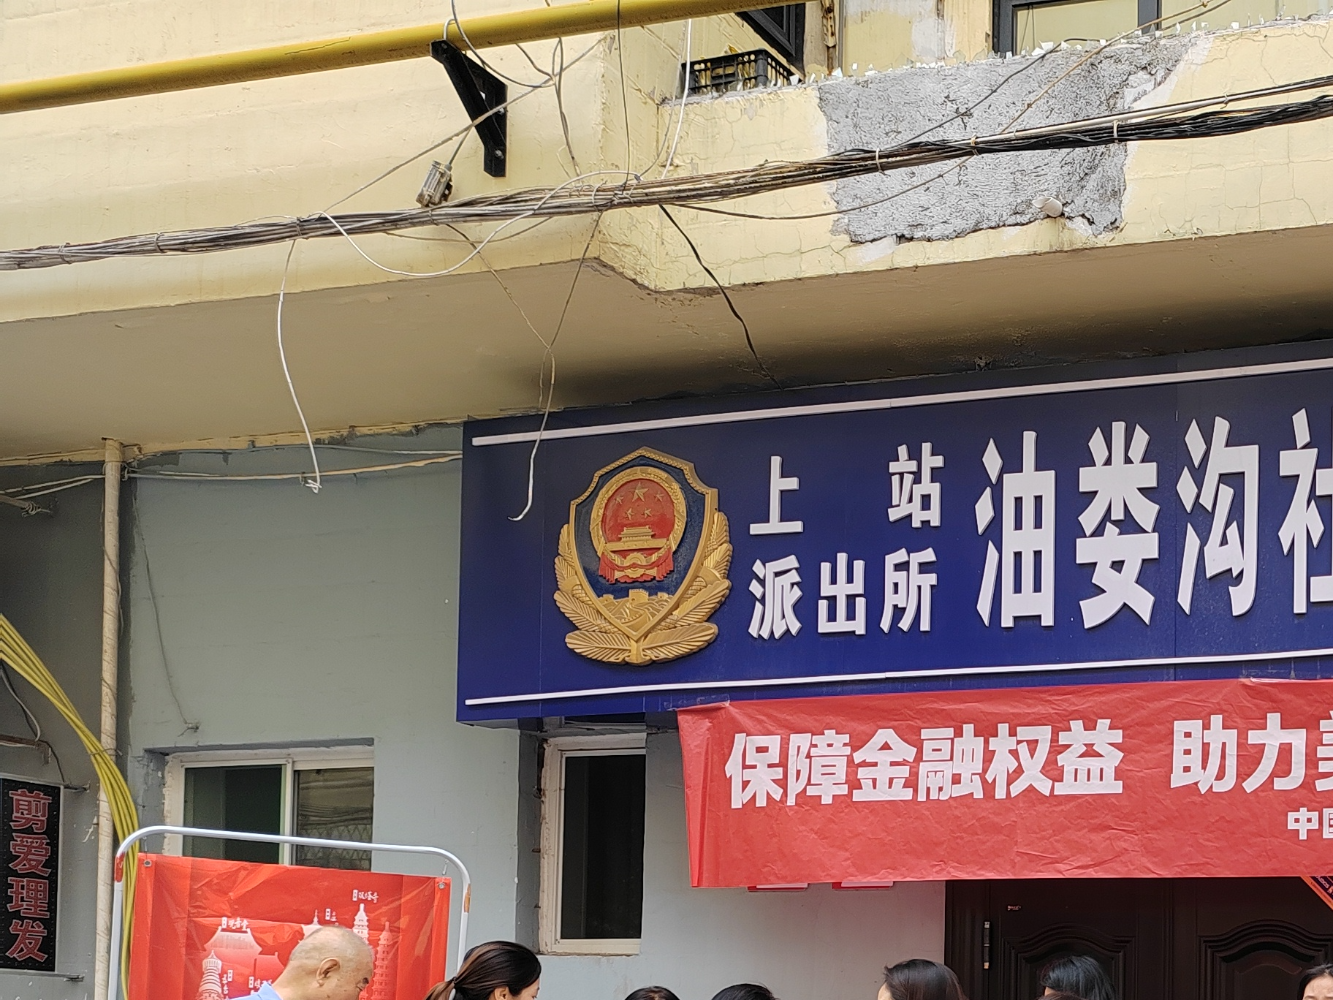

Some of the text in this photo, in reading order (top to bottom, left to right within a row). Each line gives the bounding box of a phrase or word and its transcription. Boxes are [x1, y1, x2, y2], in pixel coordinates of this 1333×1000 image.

[749, 547, 938, 640] 派出所
[724, 719, 1123, 808] 保障金融权益
[6, 789, 52, 962] 剪爱理发
